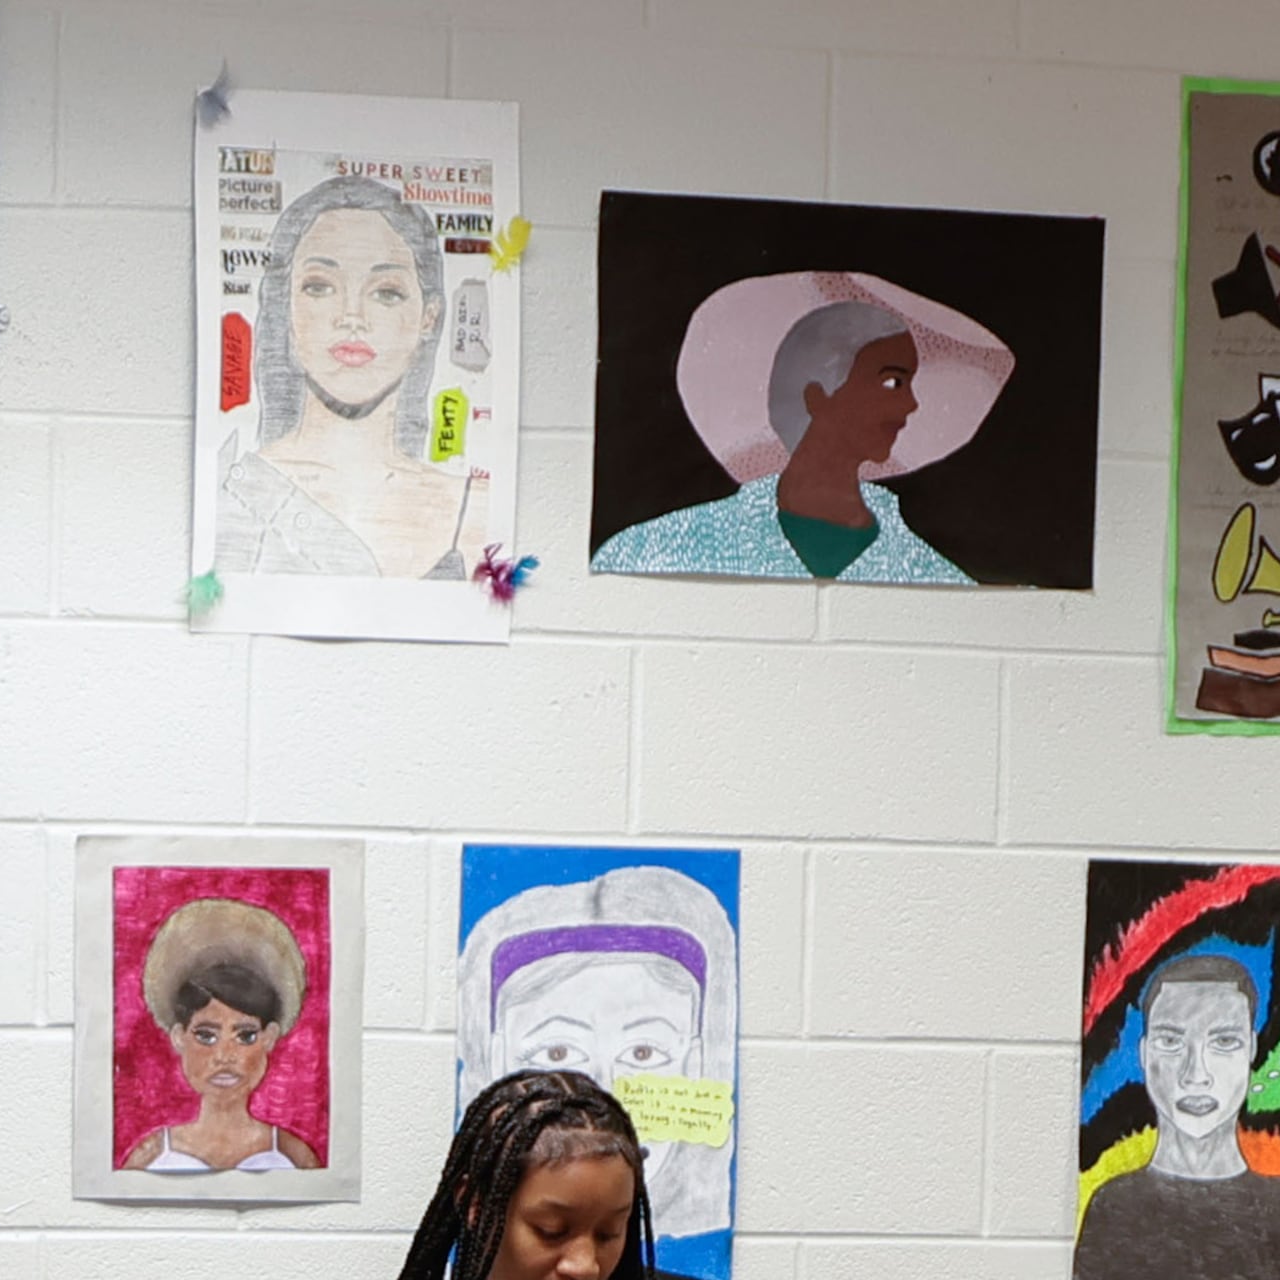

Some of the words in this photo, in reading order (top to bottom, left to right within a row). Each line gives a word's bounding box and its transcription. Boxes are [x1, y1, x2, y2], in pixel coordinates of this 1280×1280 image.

[338, 160, 402, 180] SUPER
[413, 165, 481, 184] SWEET
[404, 182, 493, 206] Showtime
[436, 213, 494, 233] FAMILY
[438, 396, 459, 453] FENTY
